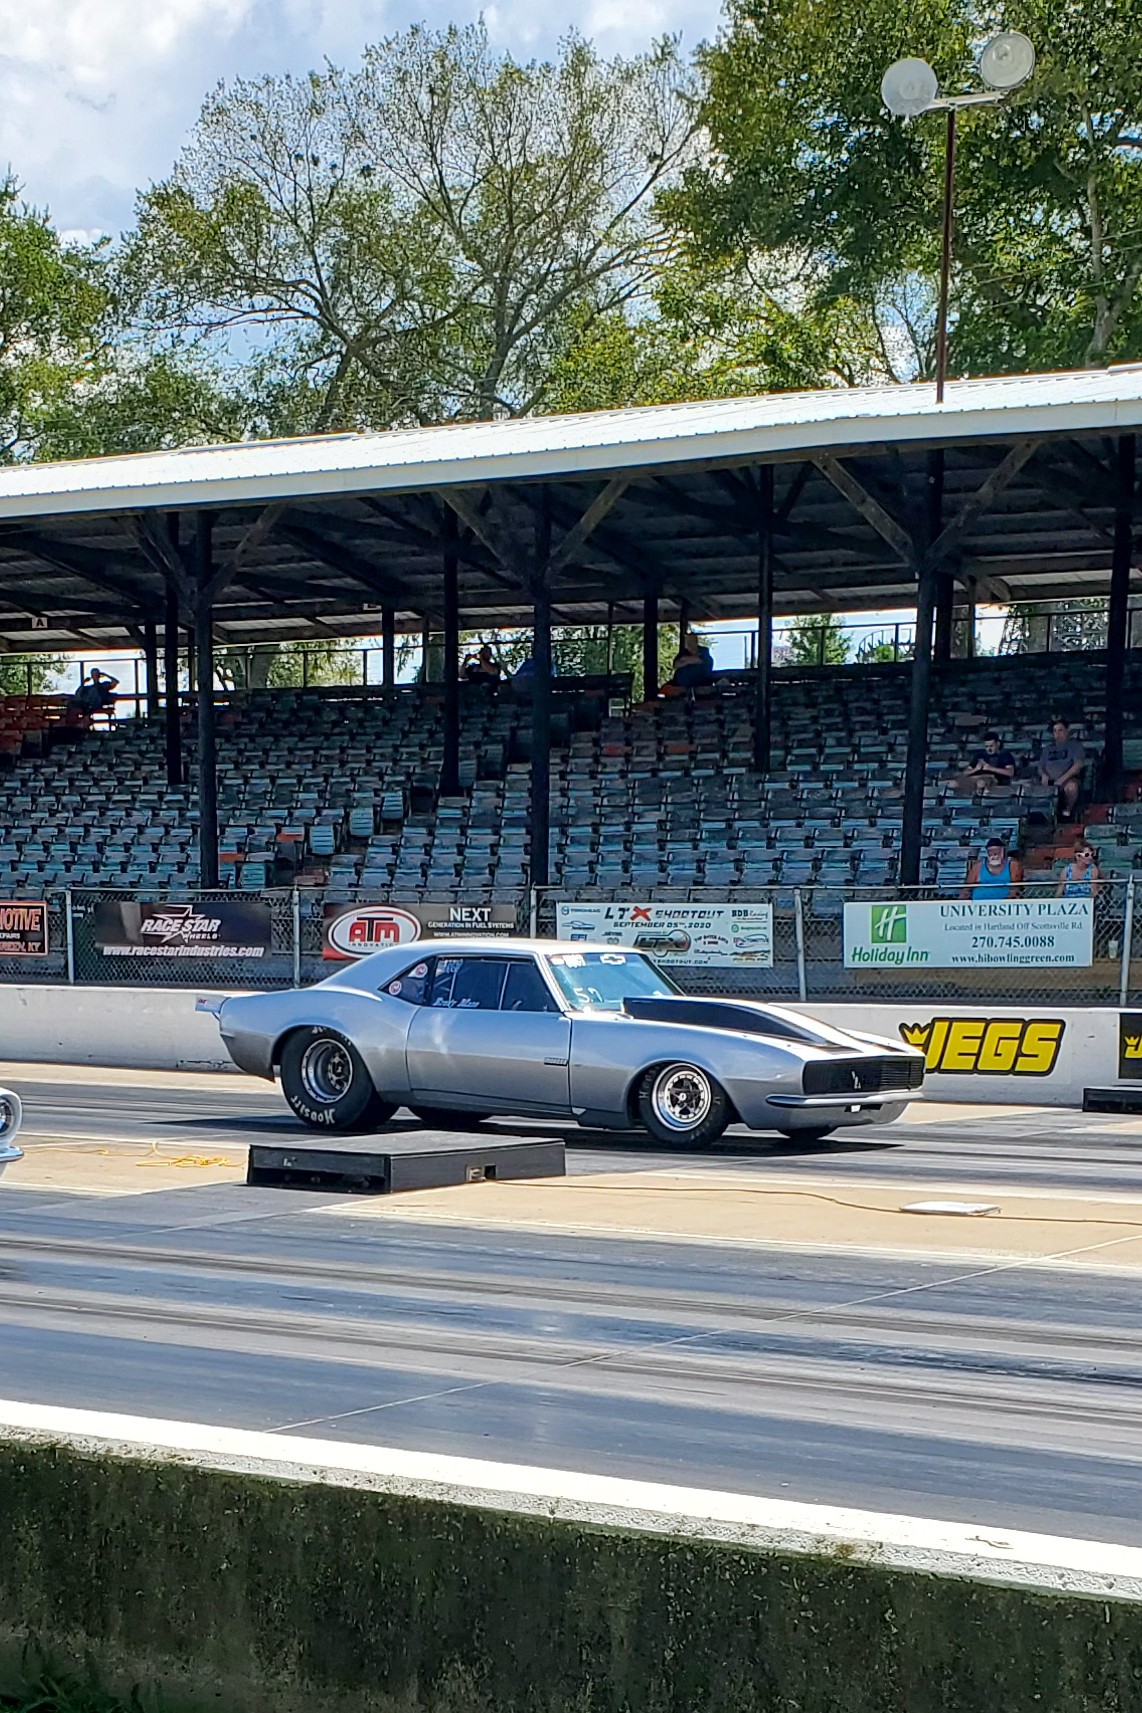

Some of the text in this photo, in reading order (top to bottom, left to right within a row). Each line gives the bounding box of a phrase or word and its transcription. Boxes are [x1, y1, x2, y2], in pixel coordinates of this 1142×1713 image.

[449, 907, 491, 921] NEXT
[655, 909, 724, 919] SHOOTOUT
[940, 903, 1089, 917] UNIVERSITY PLAZA
[140, 919, 221, 932] RACE STAR
[348, 917, 400, 942] ATM
[944, 923, 973, 931] Located
[975, 923, 982, 931] in
[983, 922, 1015, 931] Hartland
[1016, 921, 1030, 930] Off
[1031, 921, 1070, 930] Scottsville
[27, 942, 41, 952] KY
[971, 935, 1055, 948] 270.745.0088
[102, 945, 264, 957] www.racestarindustries.com
[851, 946, 929, 965] Holiday Inn
[951, 952, 1076, 964] www.hibowlinggreen.com
[915, 1021, 1062, 1072] JEGS
